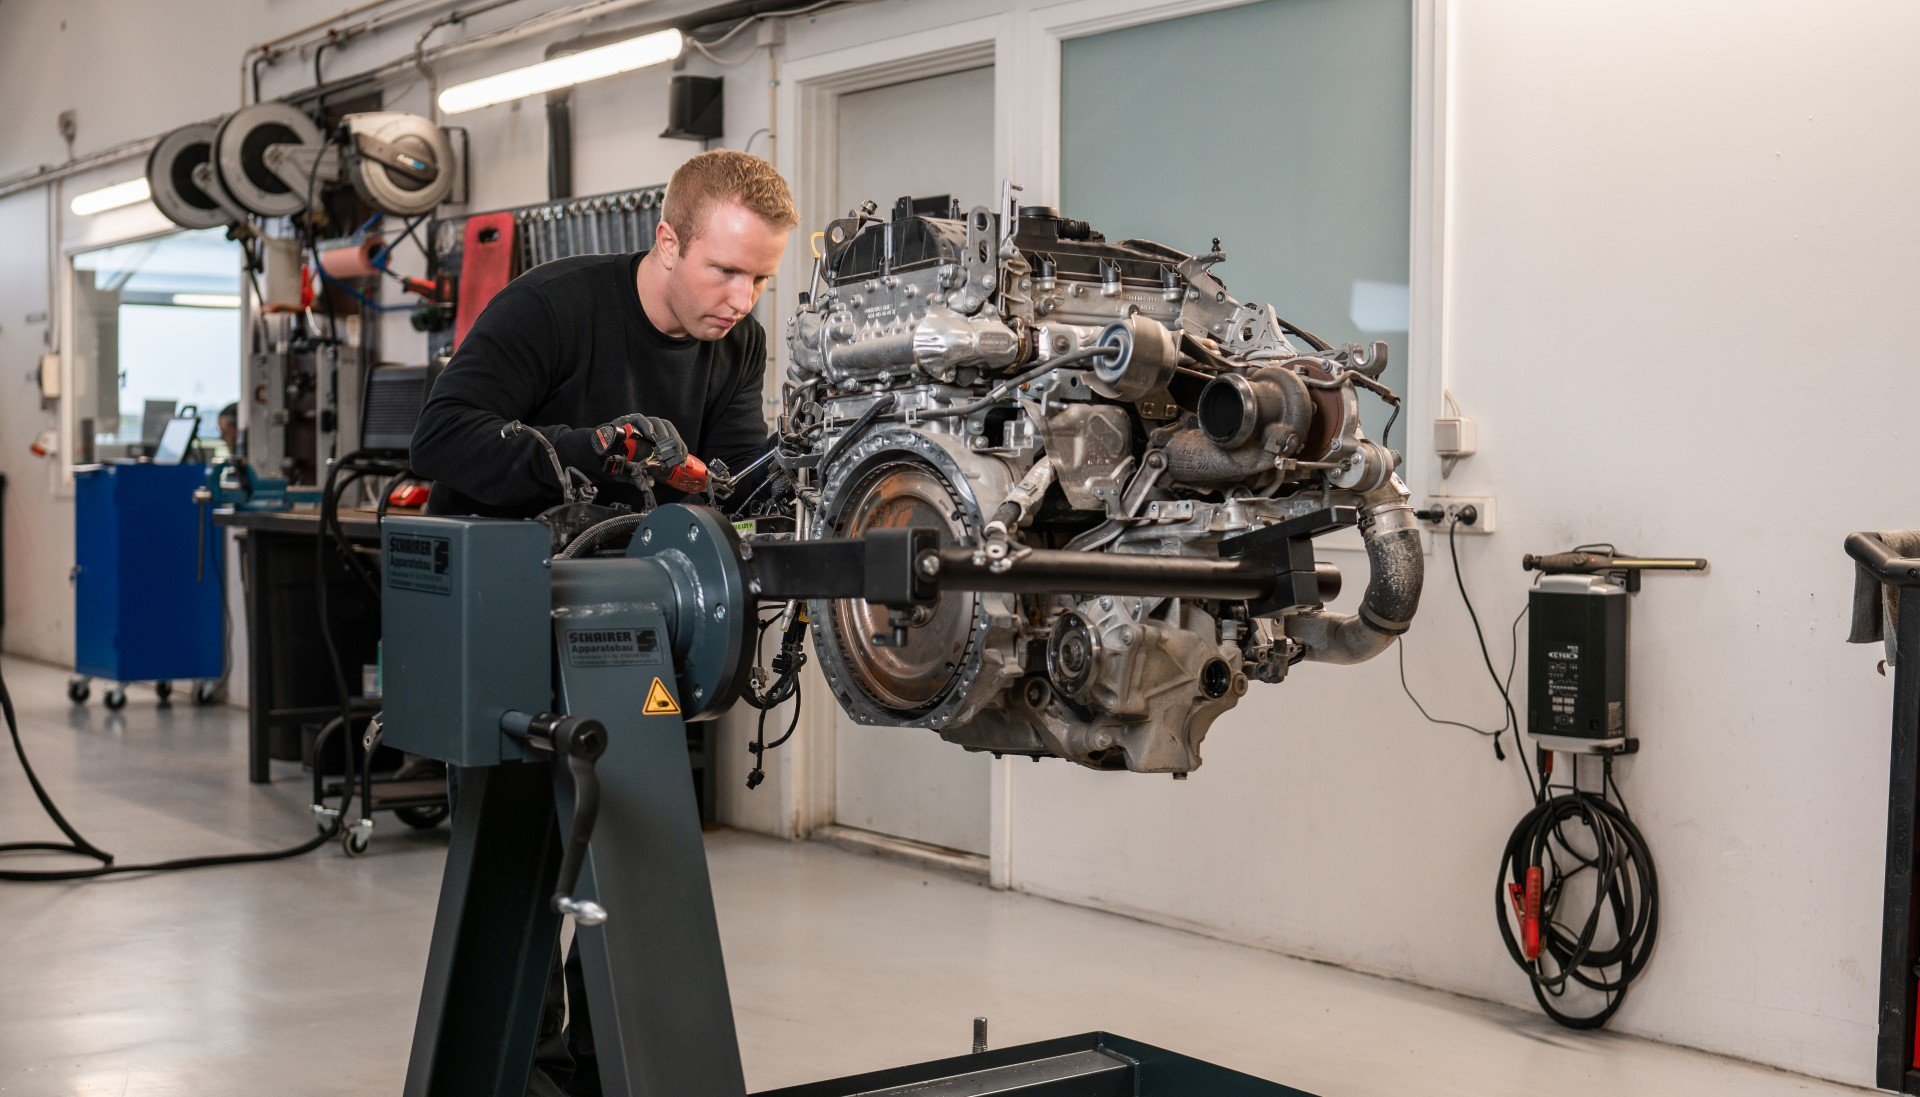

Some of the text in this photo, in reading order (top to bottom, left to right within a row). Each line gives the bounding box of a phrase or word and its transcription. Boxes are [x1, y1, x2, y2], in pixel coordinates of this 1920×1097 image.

[389, 537, 432, 556] SCHAIRER
[568, 631, 632, 644] SCHAIRER
[571, 643, 634, 654] Apparatebau
